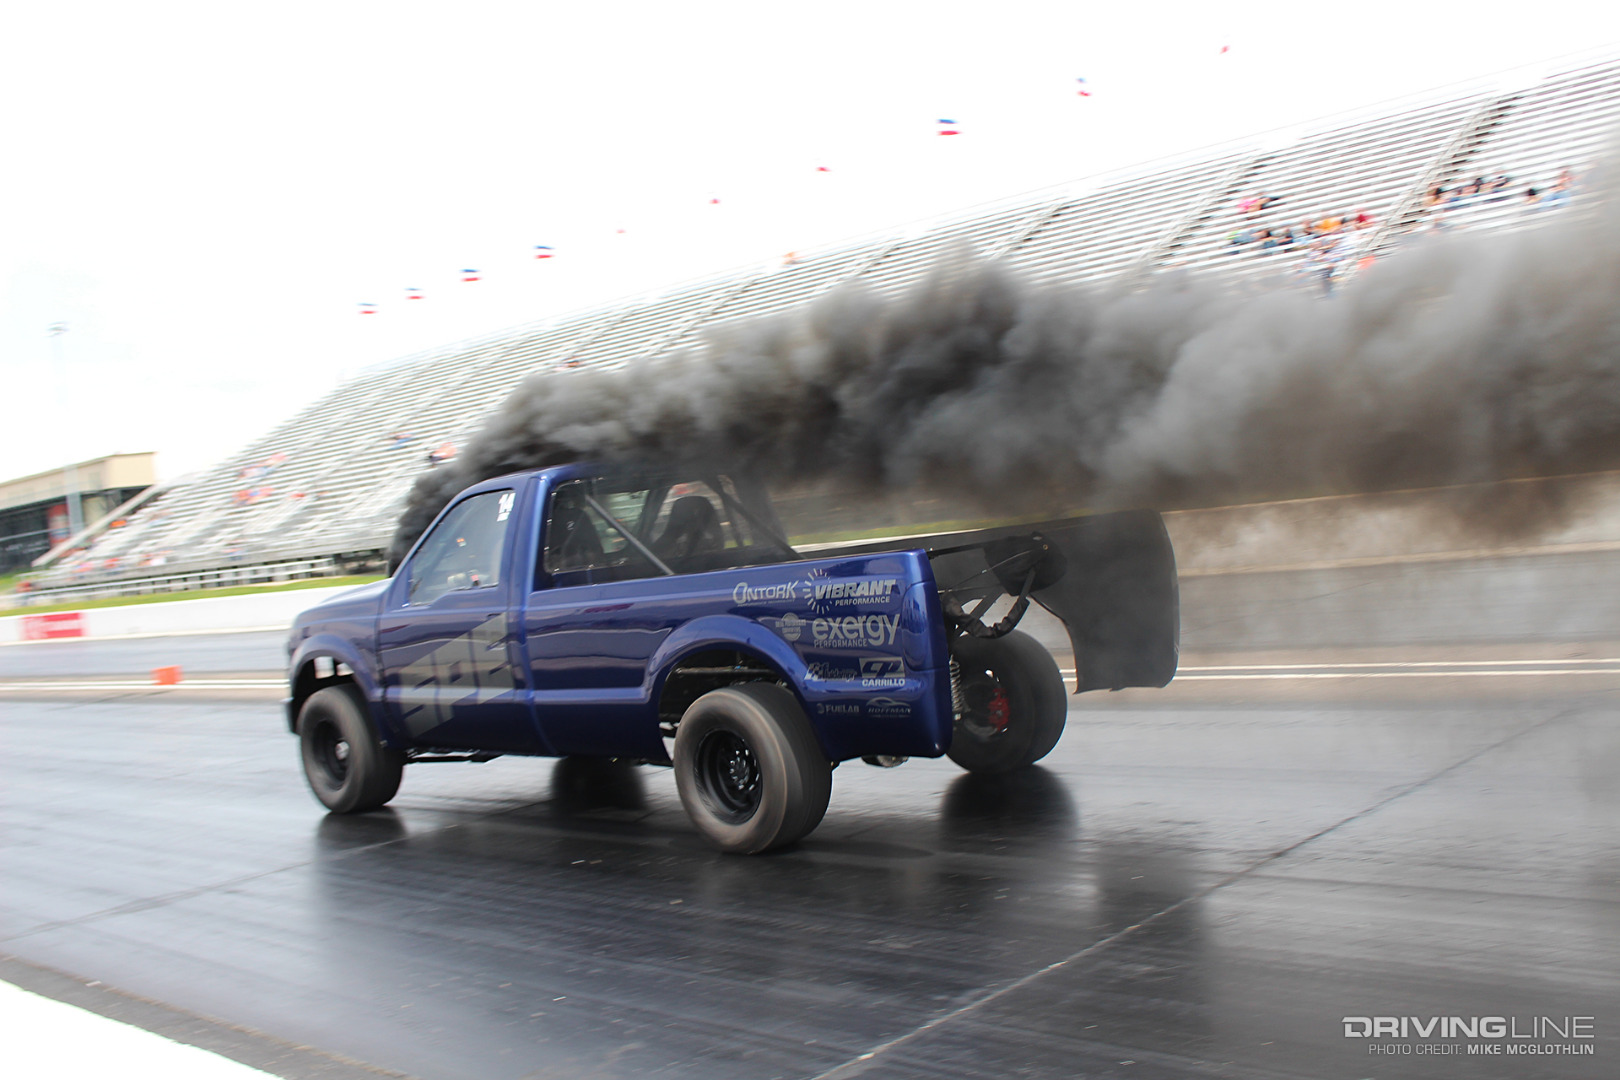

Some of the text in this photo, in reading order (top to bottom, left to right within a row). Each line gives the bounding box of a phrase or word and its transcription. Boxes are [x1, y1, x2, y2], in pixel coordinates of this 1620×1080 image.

[815, 579, 896, 600] VIBRANT
[835, 596, 890, 607] PERFORMANCE
[812, 614, 900, 646] exergy
[814, 638, 868, 648] PERFORMANCE
[862, 678, 906, 687] CARRILLO
[825, 704, 860, 713] FUELAB
